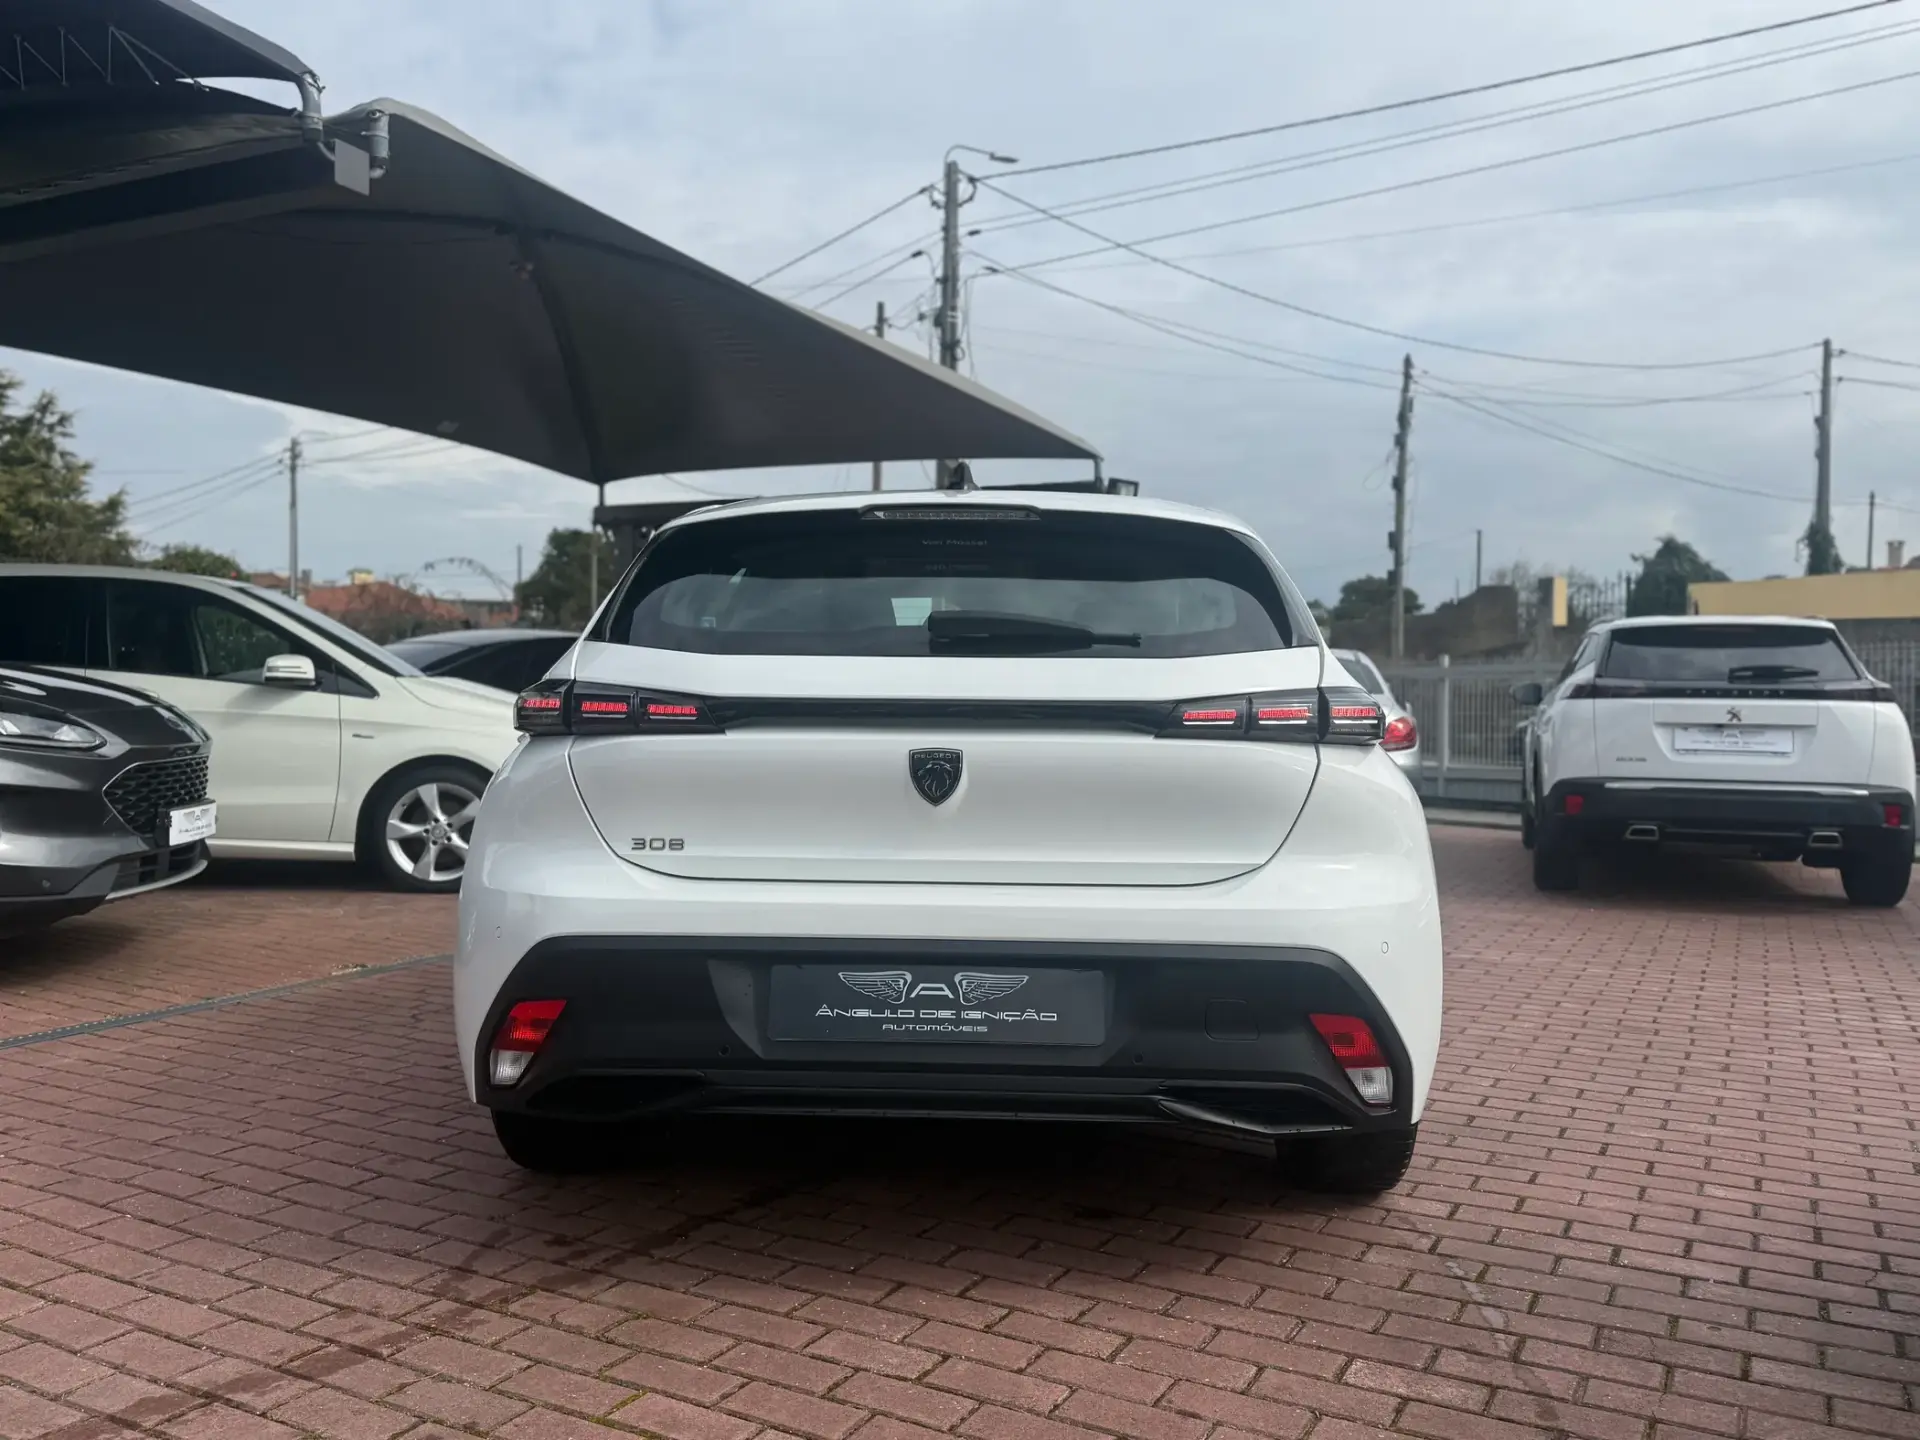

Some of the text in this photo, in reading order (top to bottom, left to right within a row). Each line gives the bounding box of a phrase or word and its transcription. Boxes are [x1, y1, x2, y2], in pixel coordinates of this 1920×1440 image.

[914, 752, 957, 760] PEUGEOT
[631, 838, 684, 851] 308
[815, 1004, 1058, 1022] ÂNGULO DE IGNIÇÃO
[882, 1023, 988, 1032] AUTOMÓVEIS
